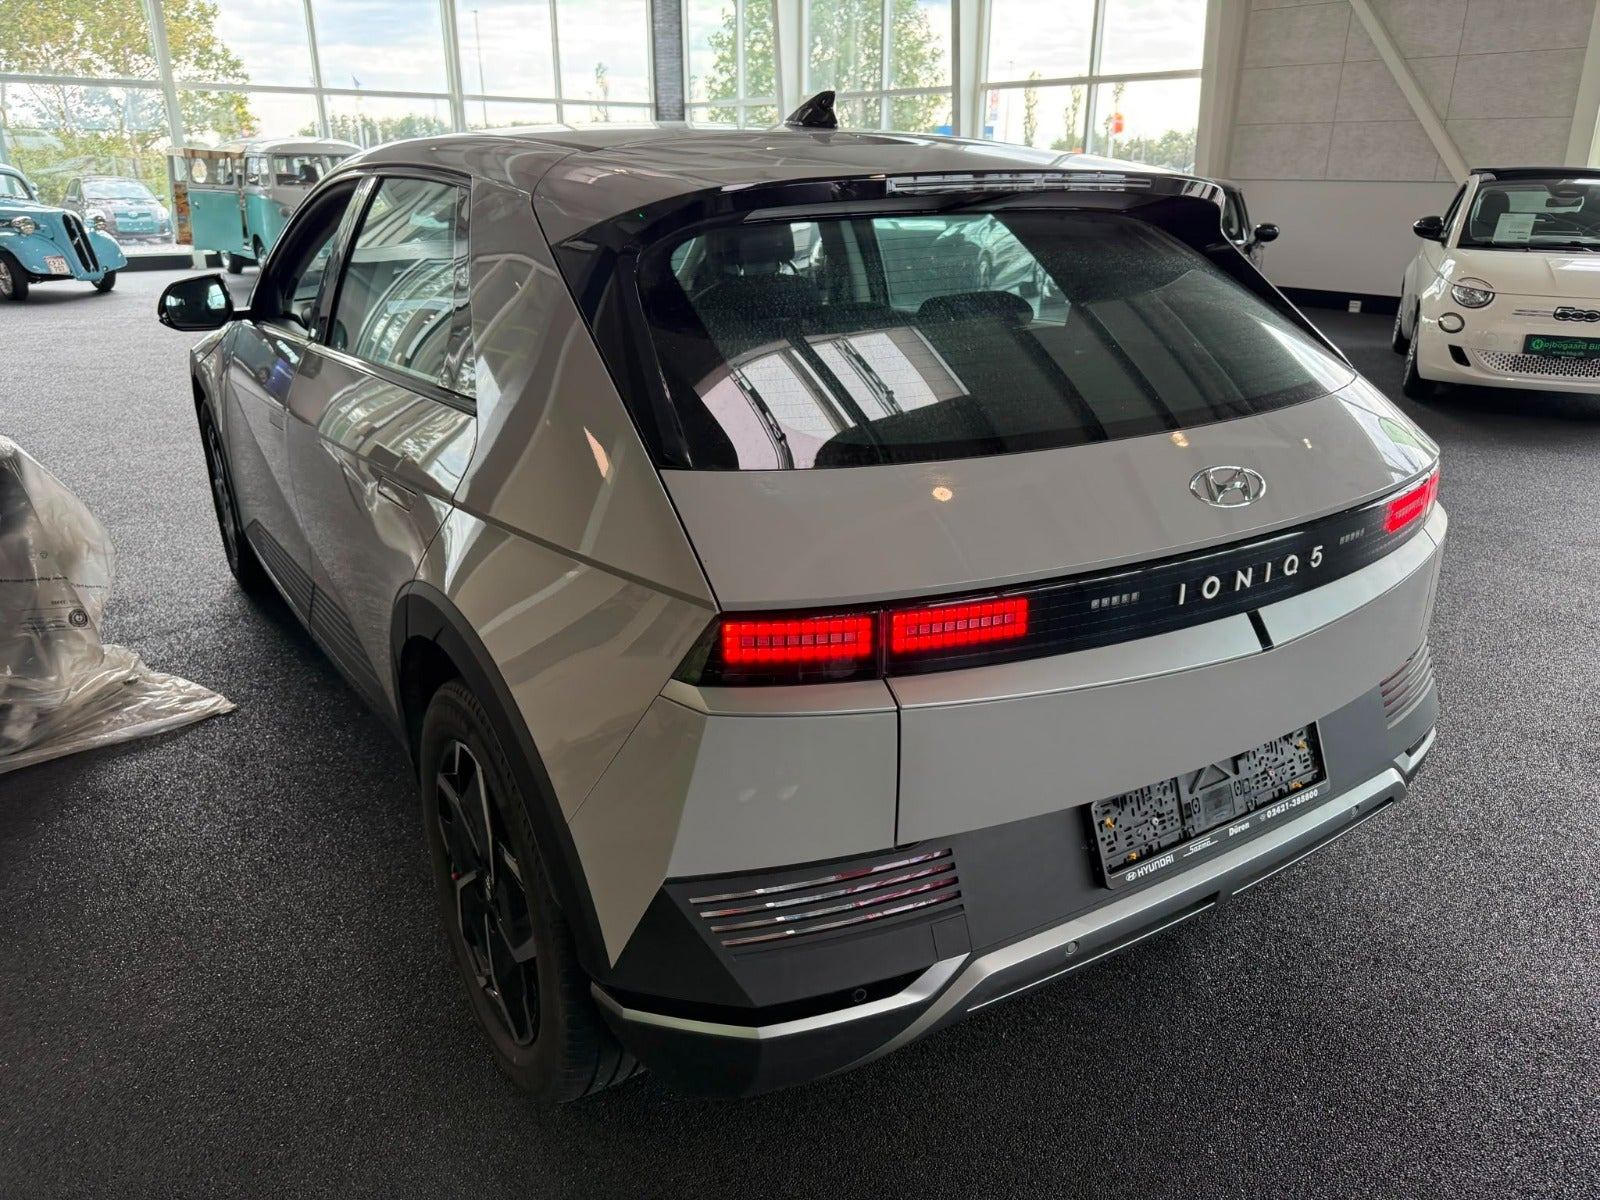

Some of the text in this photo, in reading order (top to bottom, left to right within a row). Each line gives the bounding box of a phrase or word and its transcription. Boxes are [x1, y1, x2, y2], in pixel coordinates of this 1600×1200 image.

[1178, 545, 1323, 605] IONIQ 5
[1137, 854, 1174, 878] HYUNDAI
[1228, 822, 1250, 836] Düren
